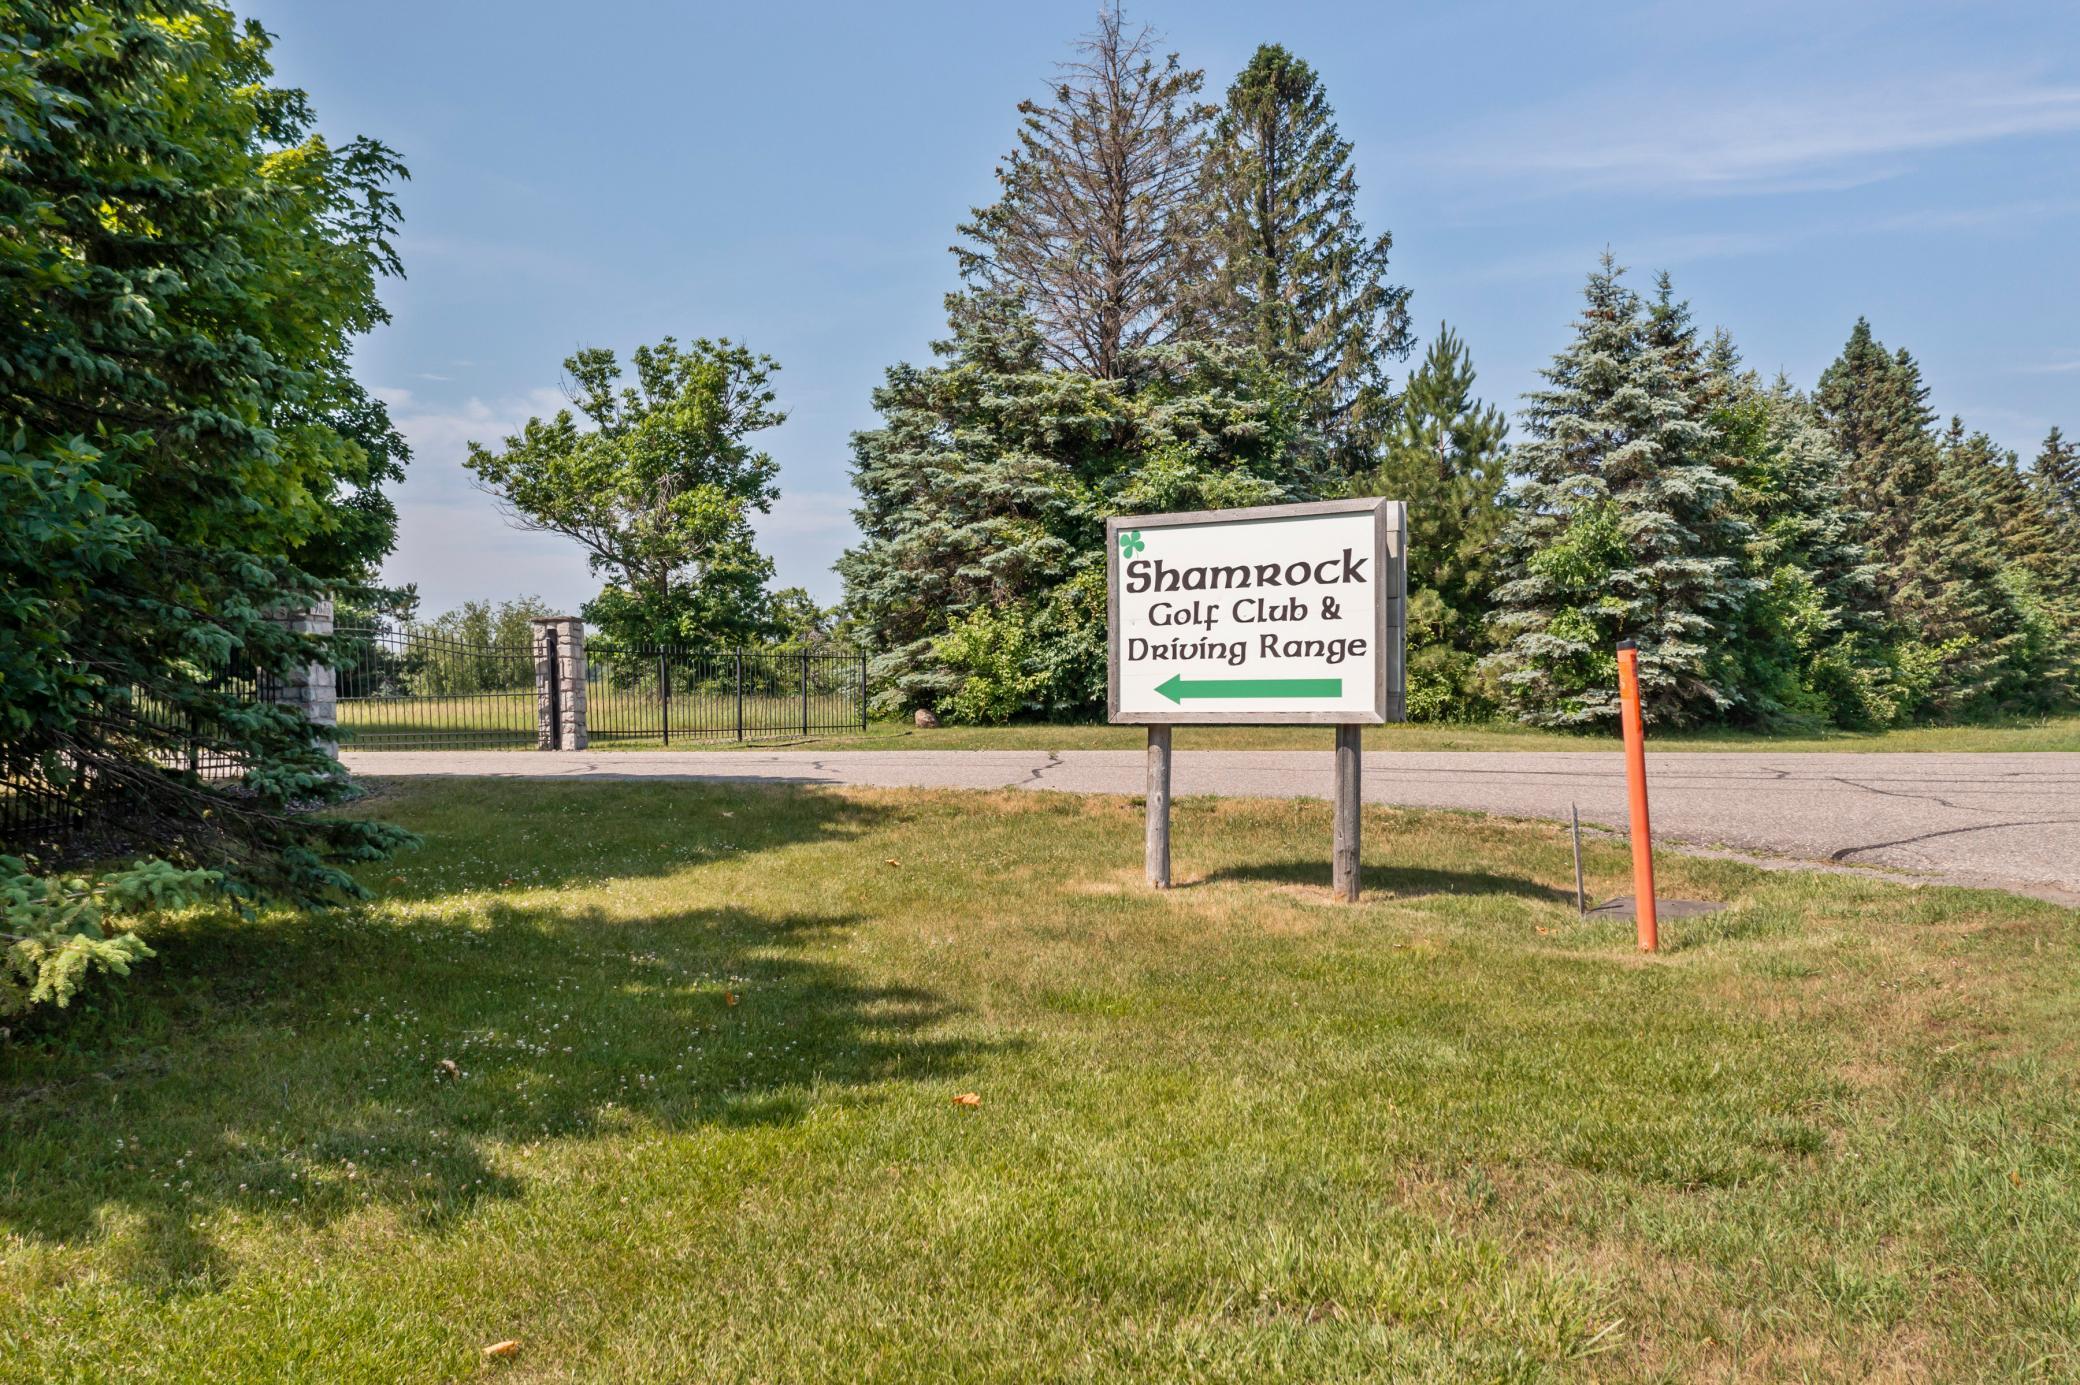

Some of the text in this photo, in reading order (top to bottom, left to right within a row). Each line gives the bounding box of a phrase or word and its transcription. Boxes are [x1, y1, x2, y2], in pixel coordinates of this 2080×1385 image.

[1126, 548, 1368, 593] Shamrock
[1148, 596, 1342, 631] Golf Club &
[1128, 634, 1367, 665] Driving Range
